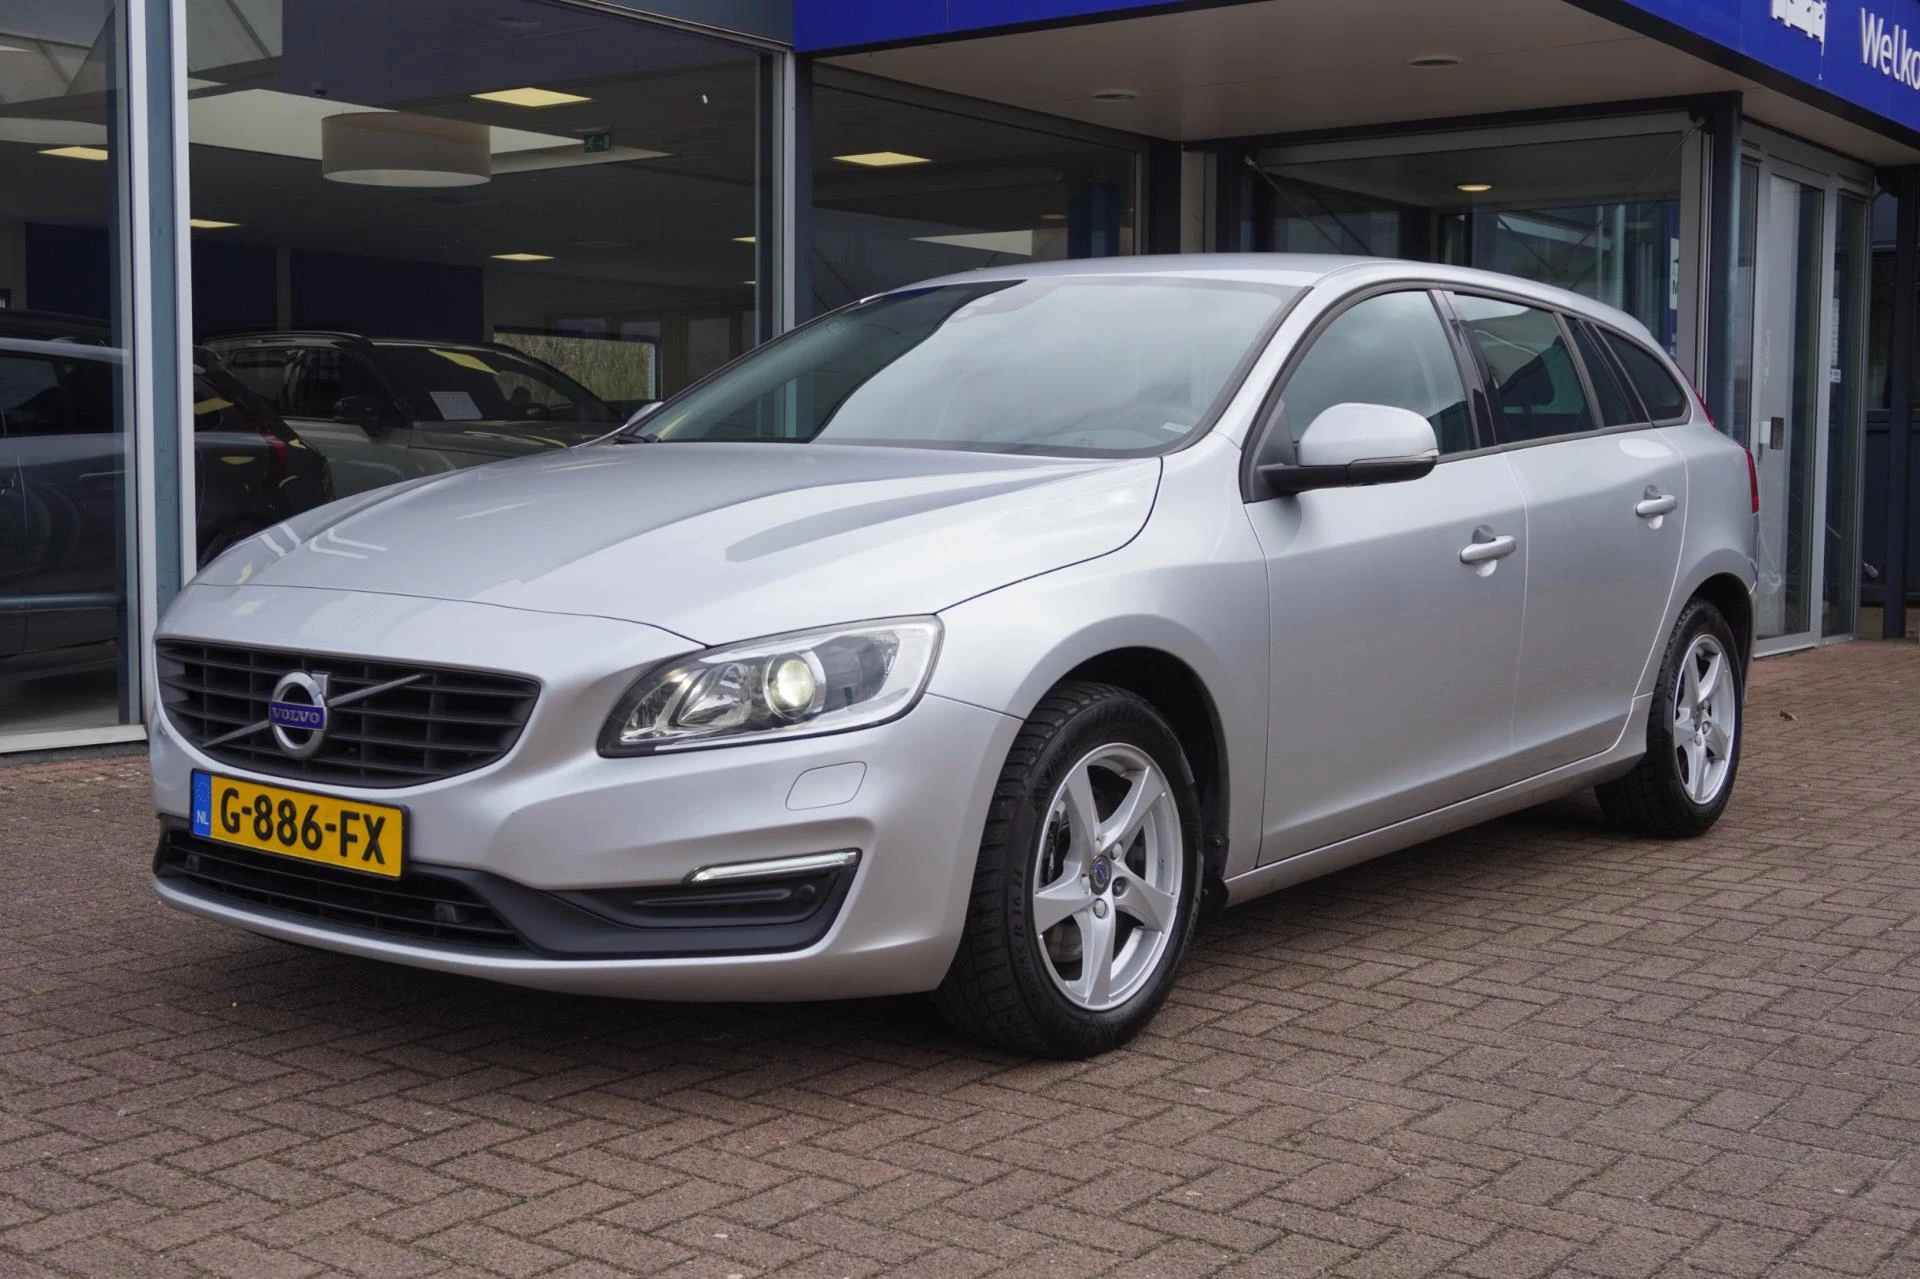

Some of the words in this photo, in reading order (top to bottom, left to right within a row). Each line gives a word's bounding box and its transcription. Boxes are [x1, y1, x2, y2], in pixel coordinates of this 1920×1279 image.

[1860, 7, 1920, 91] Welko
[271, 706, 321, 723] VOLVO
[196, 810, 209, 826] NL
[220, 787, 386, 865] G-886-FX
